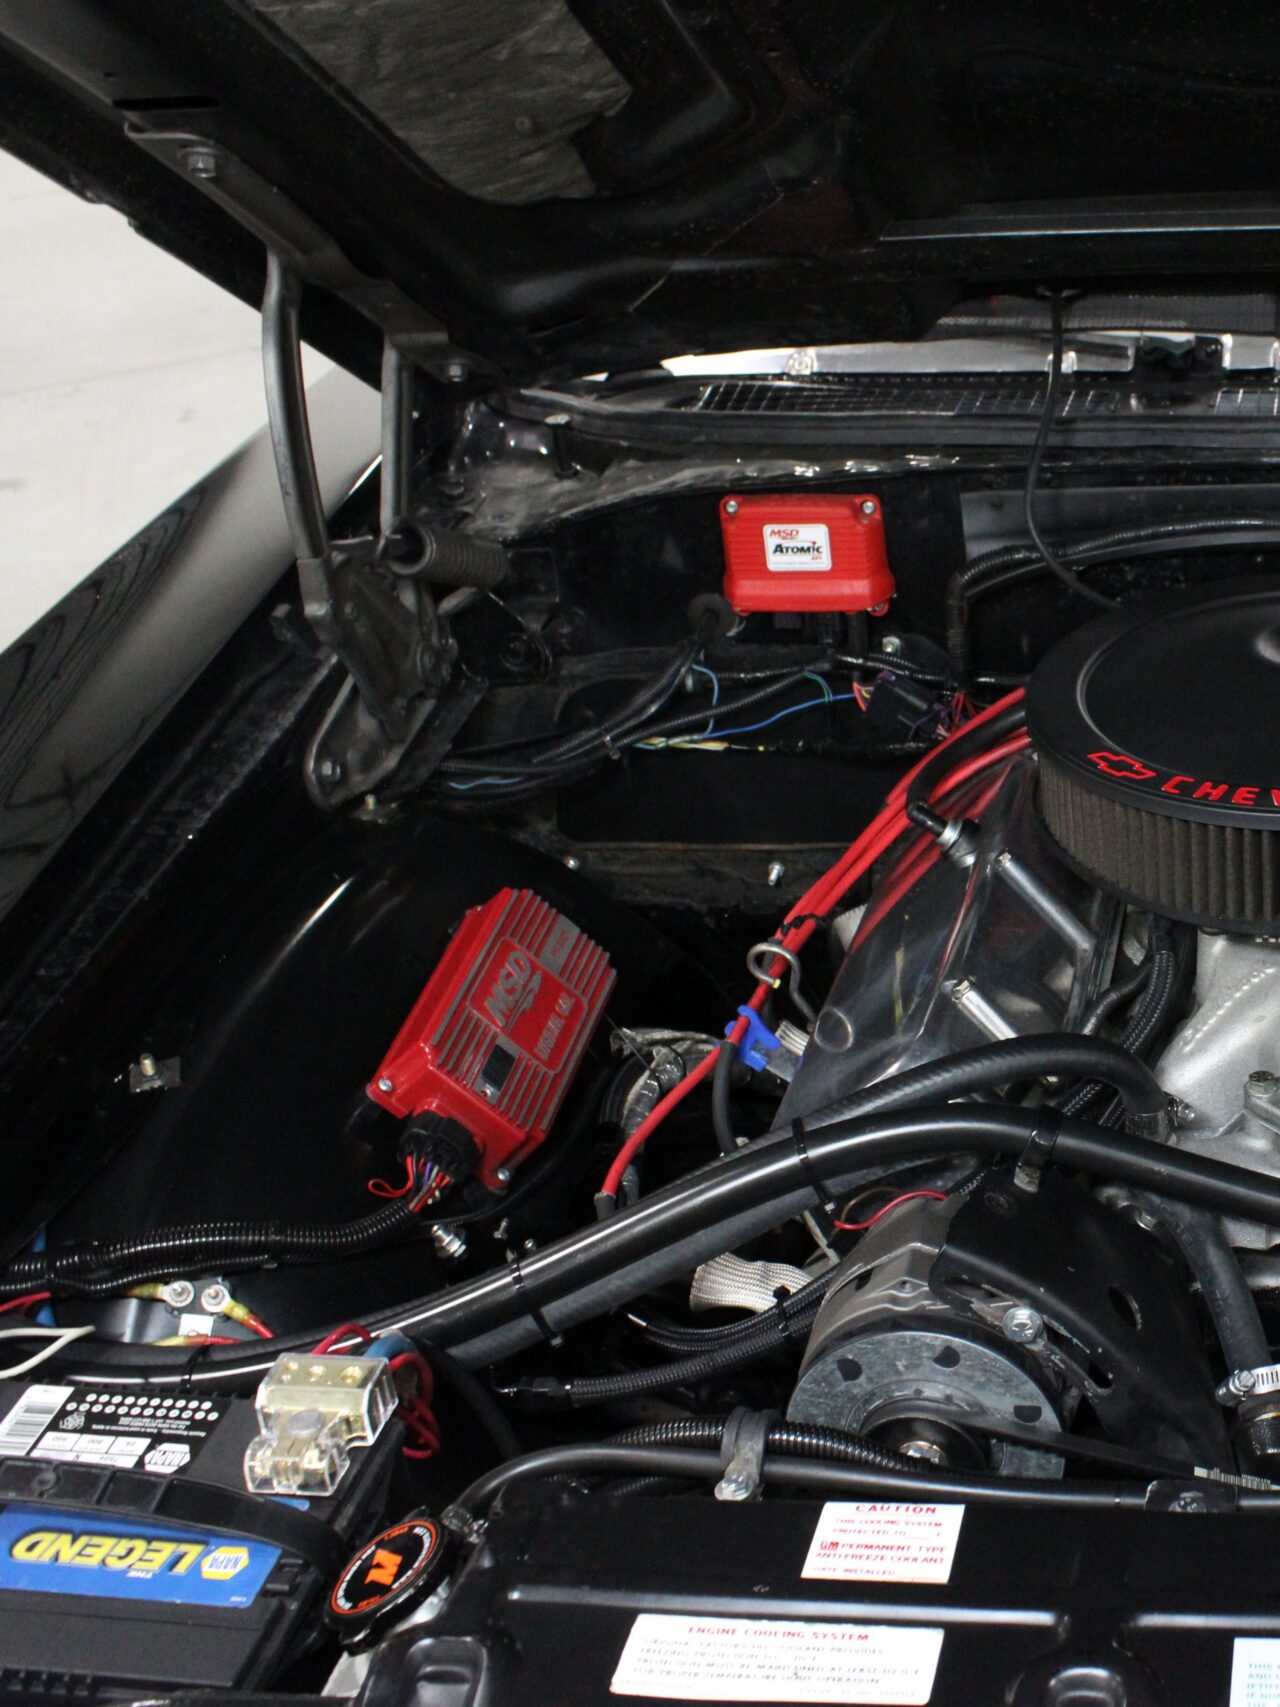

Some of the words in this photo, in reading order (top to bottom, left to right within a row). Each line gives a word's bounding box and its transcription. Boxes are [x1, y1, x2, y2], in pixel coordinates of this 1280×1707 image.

[769, 529, 800, 538] MSD
[484, 950, 532, 1029] MSD
[855, 1504, 937, 1514] CAUTION
[10, 1530, 208, 1576] LEGEND
[820, 1541, 840, 1551] GM
[841, 1543, 911, 1552] PERMANENT
[918, 1546, 945, 1554] TYPE
[209, 1553, 242, 1571] NAPA
[890, 1555, 944, 1565] COOLANT
[688, 1625, 737, 1636] ENGINE
[743, 1628, 805, 1639] COOLING
[811, 1631, 869, 1641] SYSTEM
